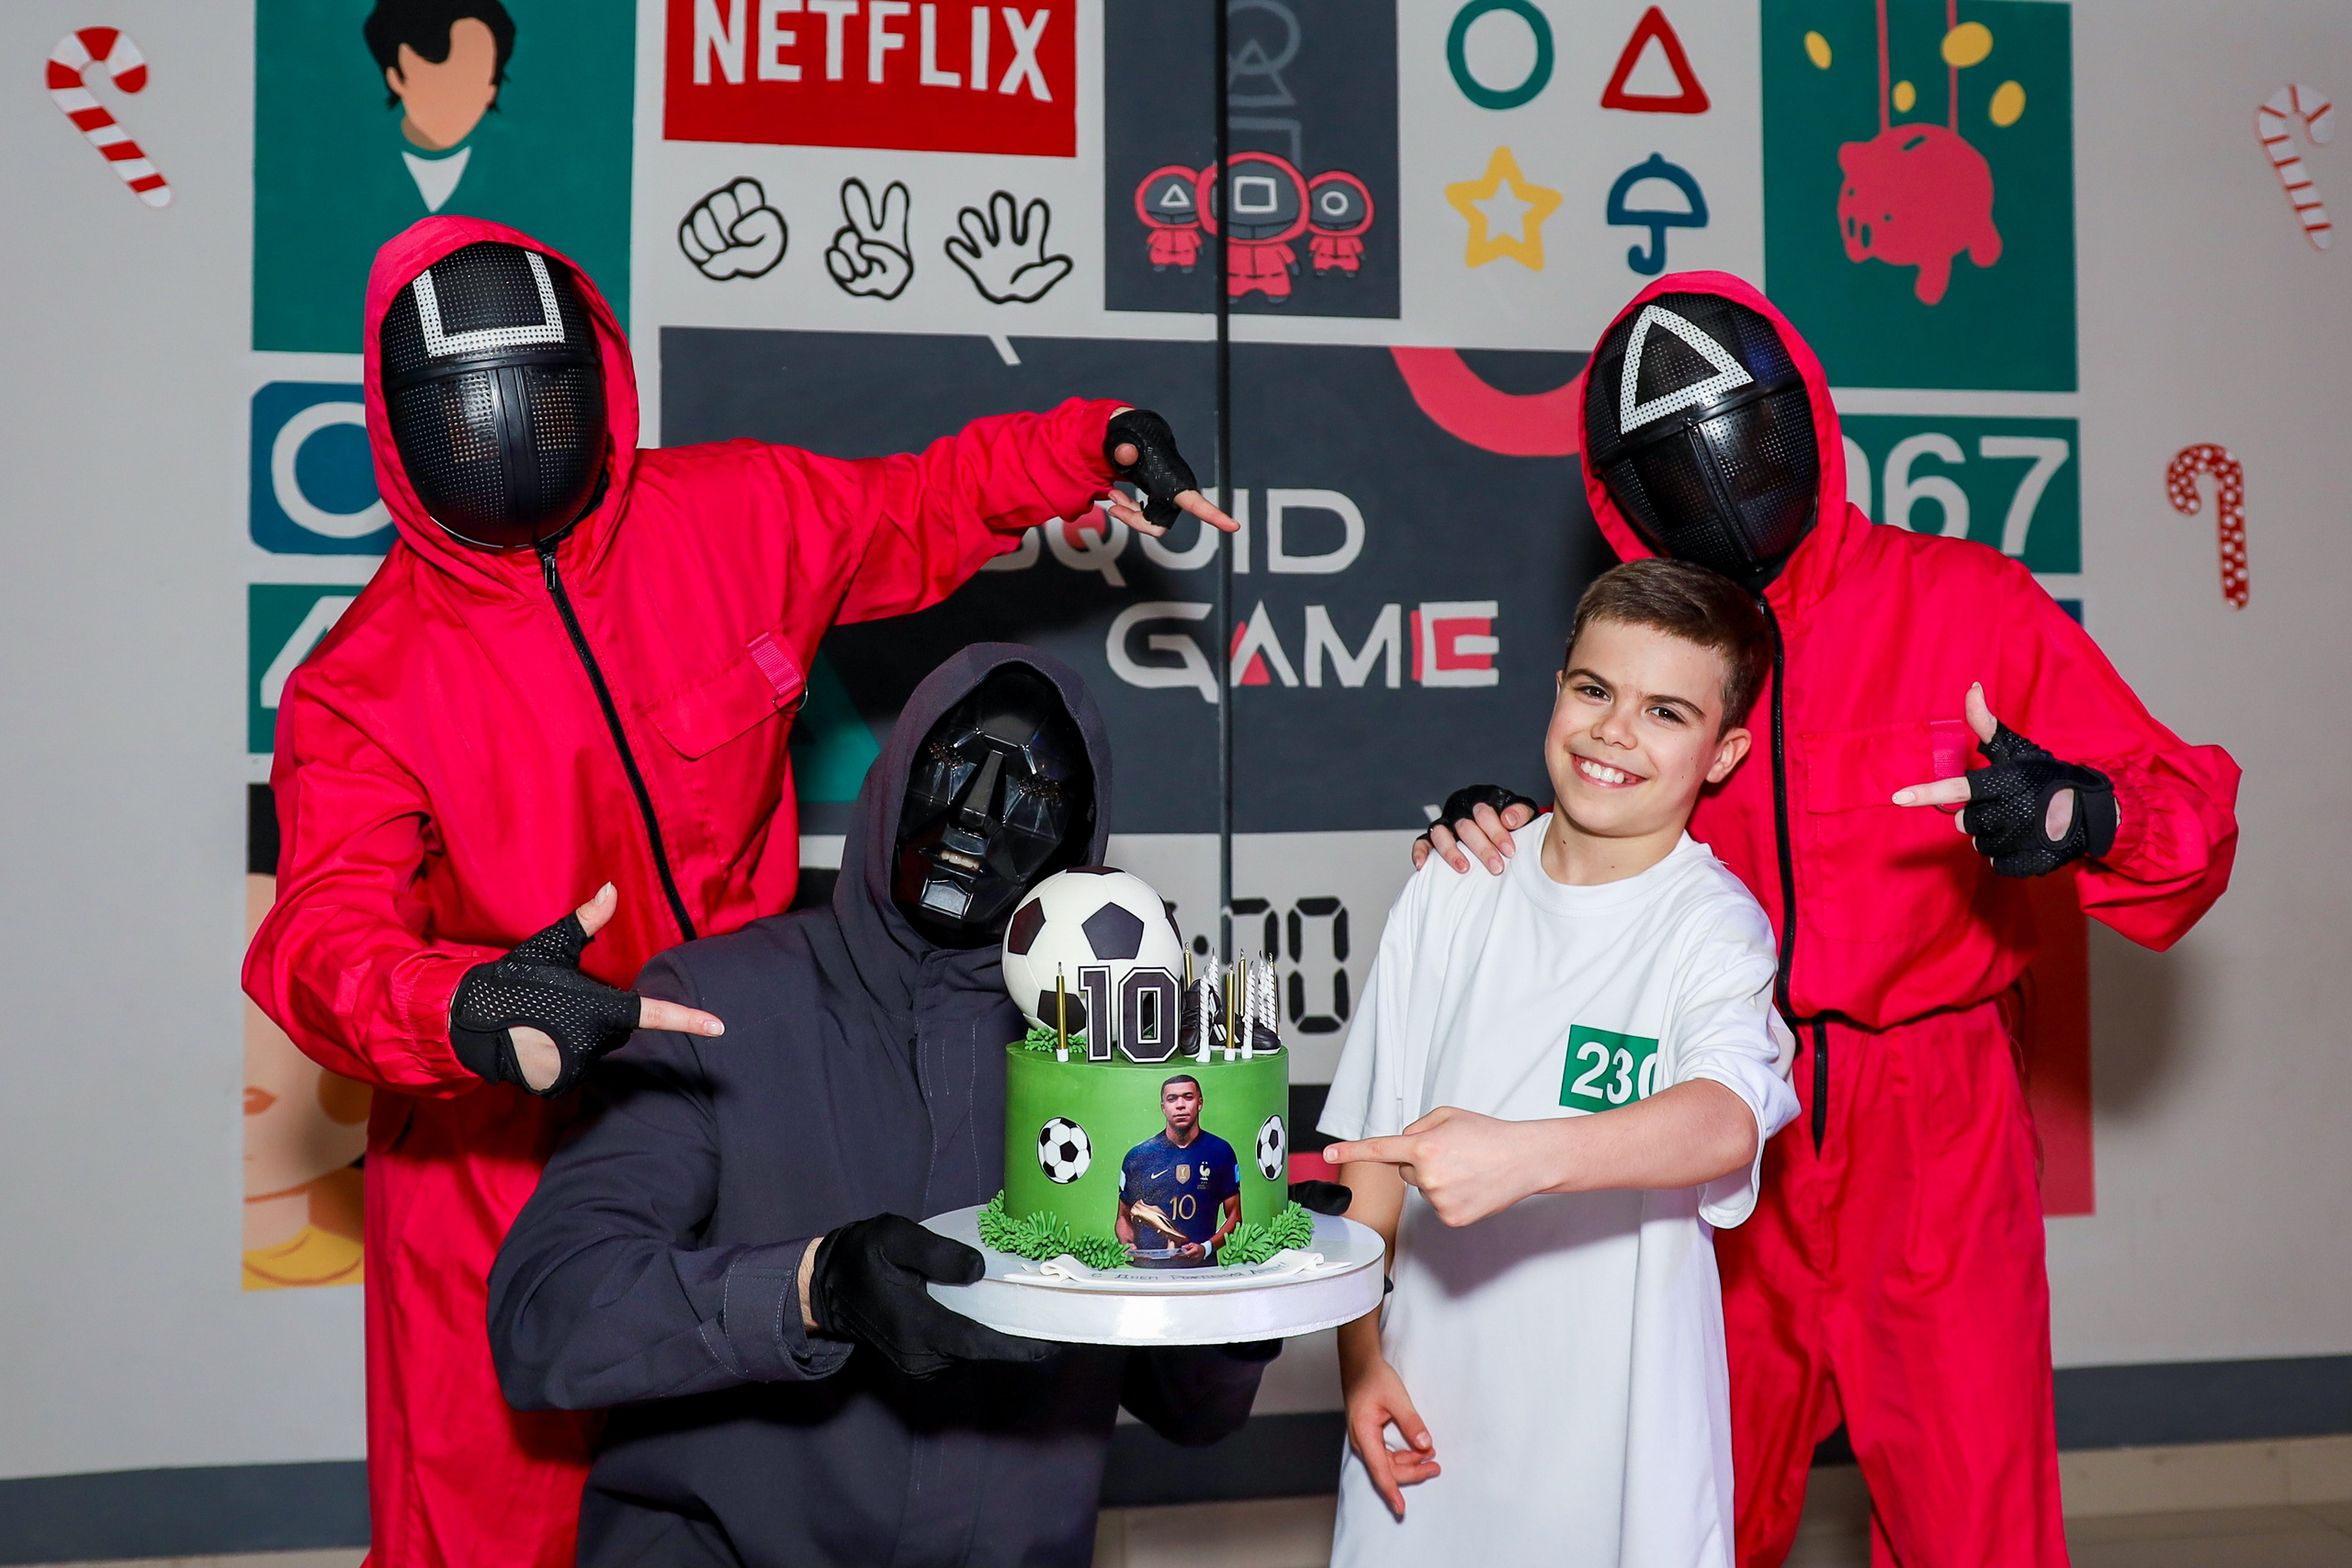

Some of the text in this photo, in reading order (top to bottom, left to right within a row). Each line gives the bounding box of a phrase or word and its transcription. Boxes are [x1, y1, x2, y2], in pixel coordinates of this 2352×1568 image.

[693, 0, 1054, 103] NETFLIX
[1105, 599, 1500, 704] GAME
[1078, 964, 1181, 1065] 10
[1170, 1193, 1197, 1221] 10
